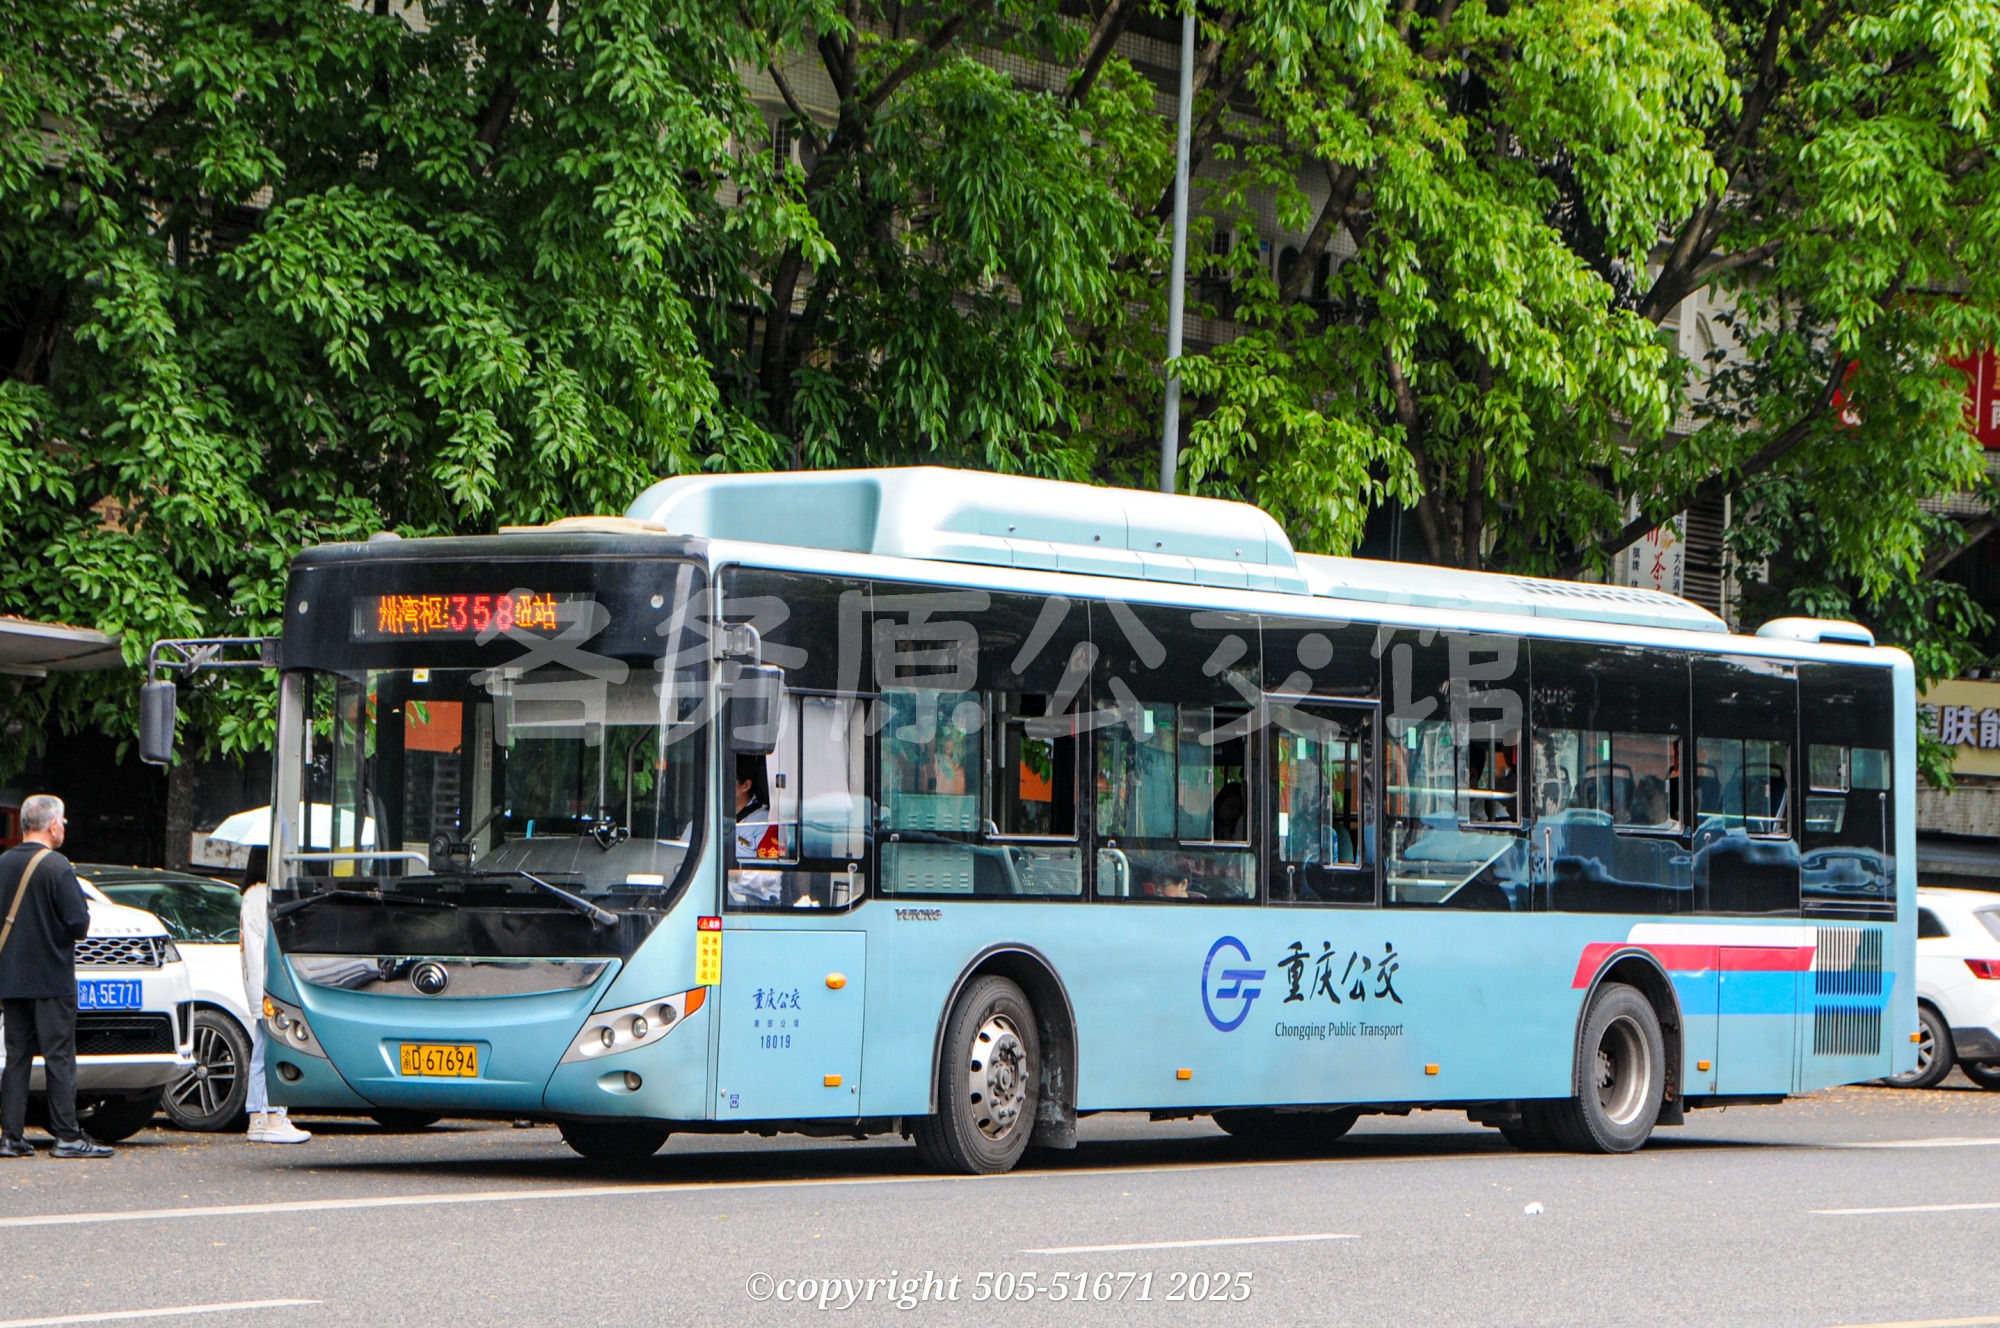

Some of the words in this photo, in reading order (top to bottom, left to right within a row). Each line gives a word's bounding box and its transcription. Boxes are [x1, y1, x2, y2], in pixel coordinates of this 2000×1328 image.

[1672, 552, 1683, 597] 大众消
[894, 908, 942, 921] YUTONG
[1277, 941, 1403, 1005] 重庆公交
[752, 988, 802, 1010] 重庆公交
[1275, 1022, 1326, 1041] Chongqing
[1328, 1022, 1357, 1037] Public
[1359, 1022, 1404, 1040] Transport
[760, 1035, 792, 1049] 18019
